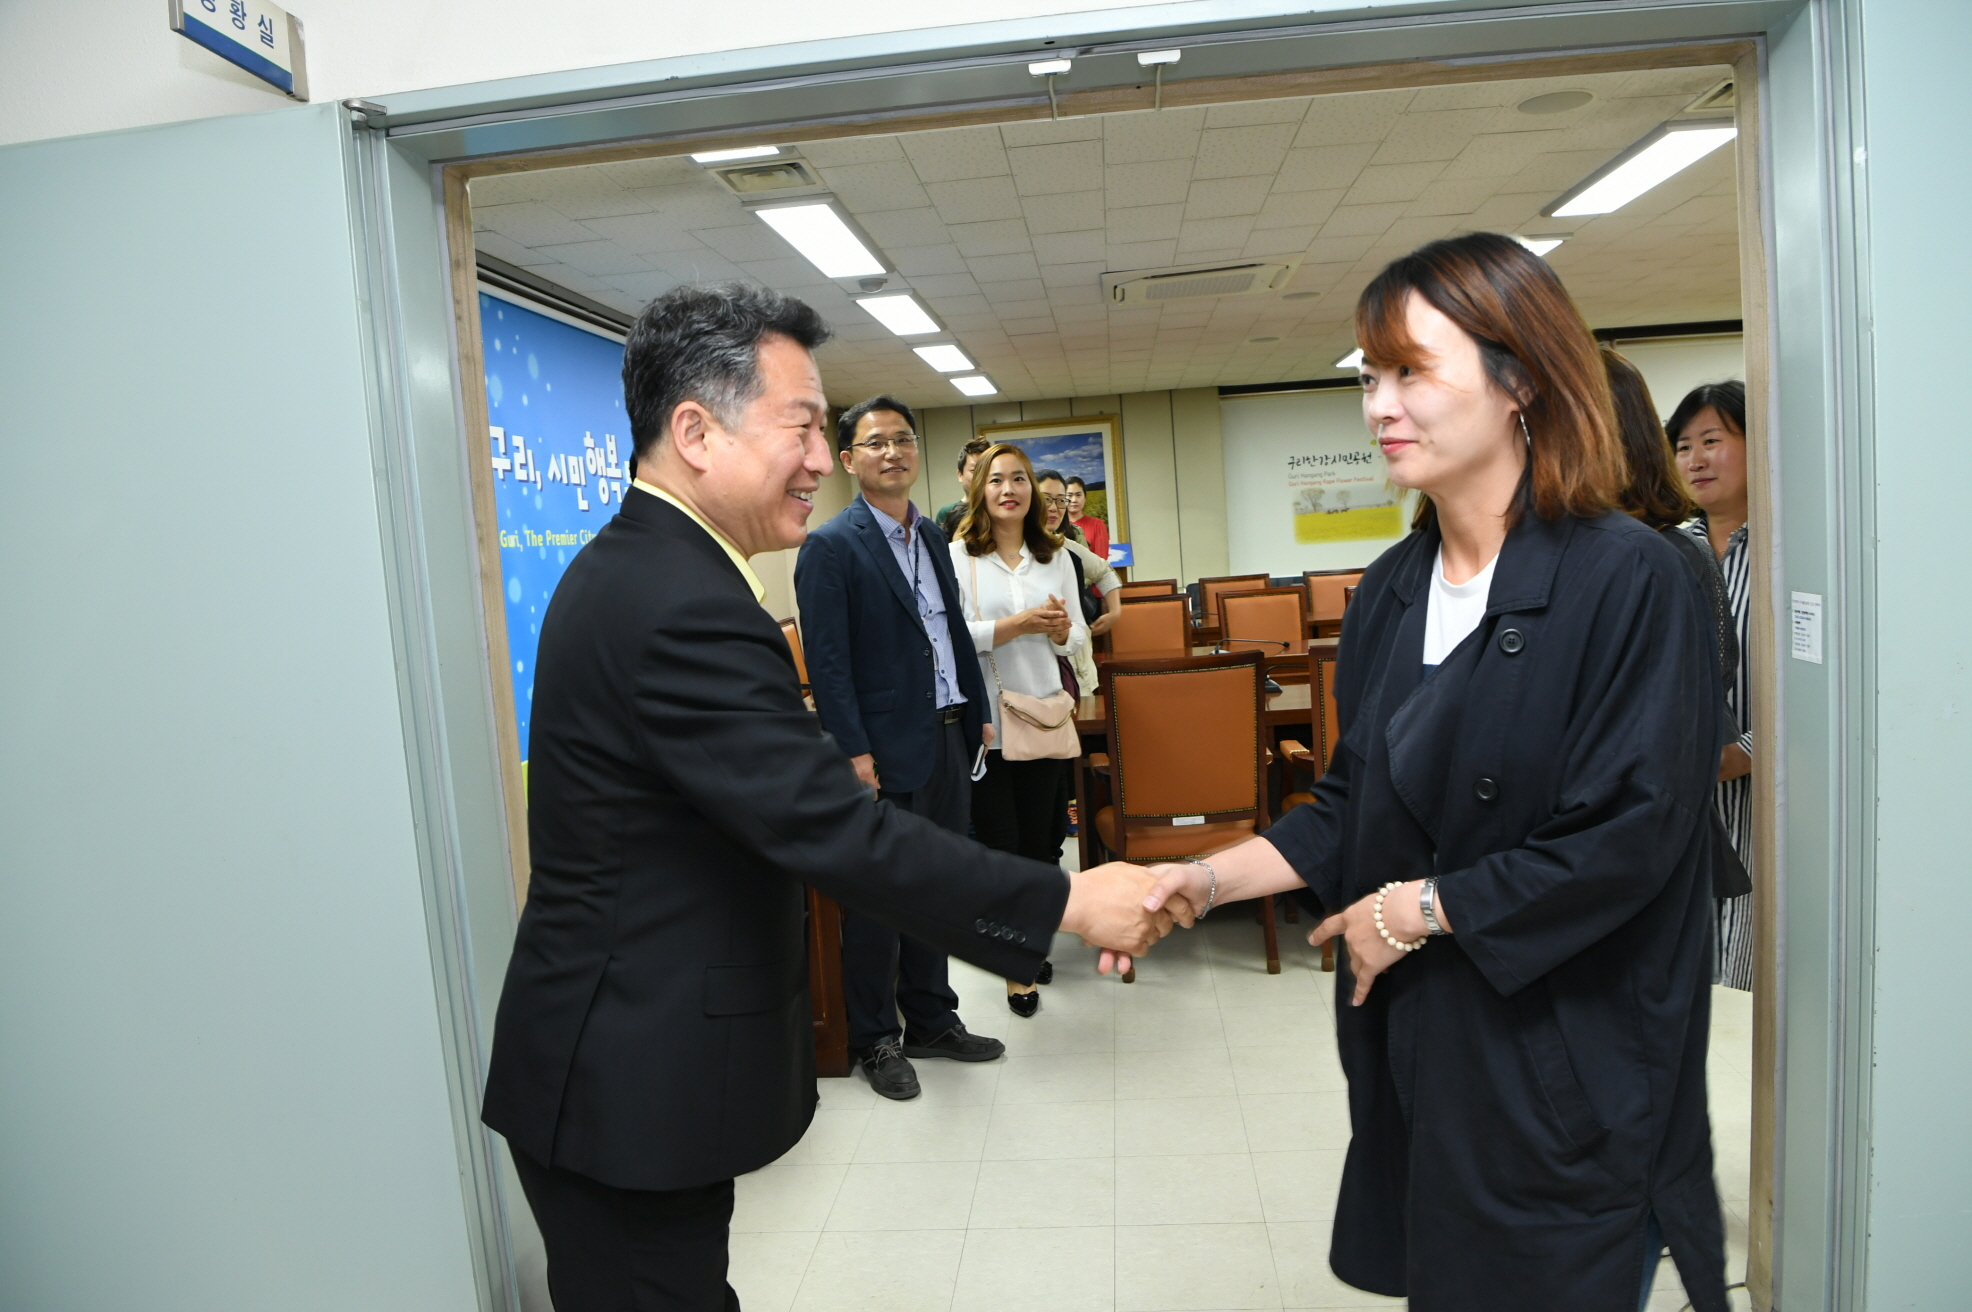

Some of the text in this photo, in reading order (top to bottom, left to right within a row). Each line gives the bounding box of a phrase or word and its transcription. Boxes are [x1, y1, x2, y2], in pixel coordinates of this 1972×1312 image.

[547, 431, 633, 510] 시민행복
[500, 529, 598, 552] Guri, The Premier Cit
